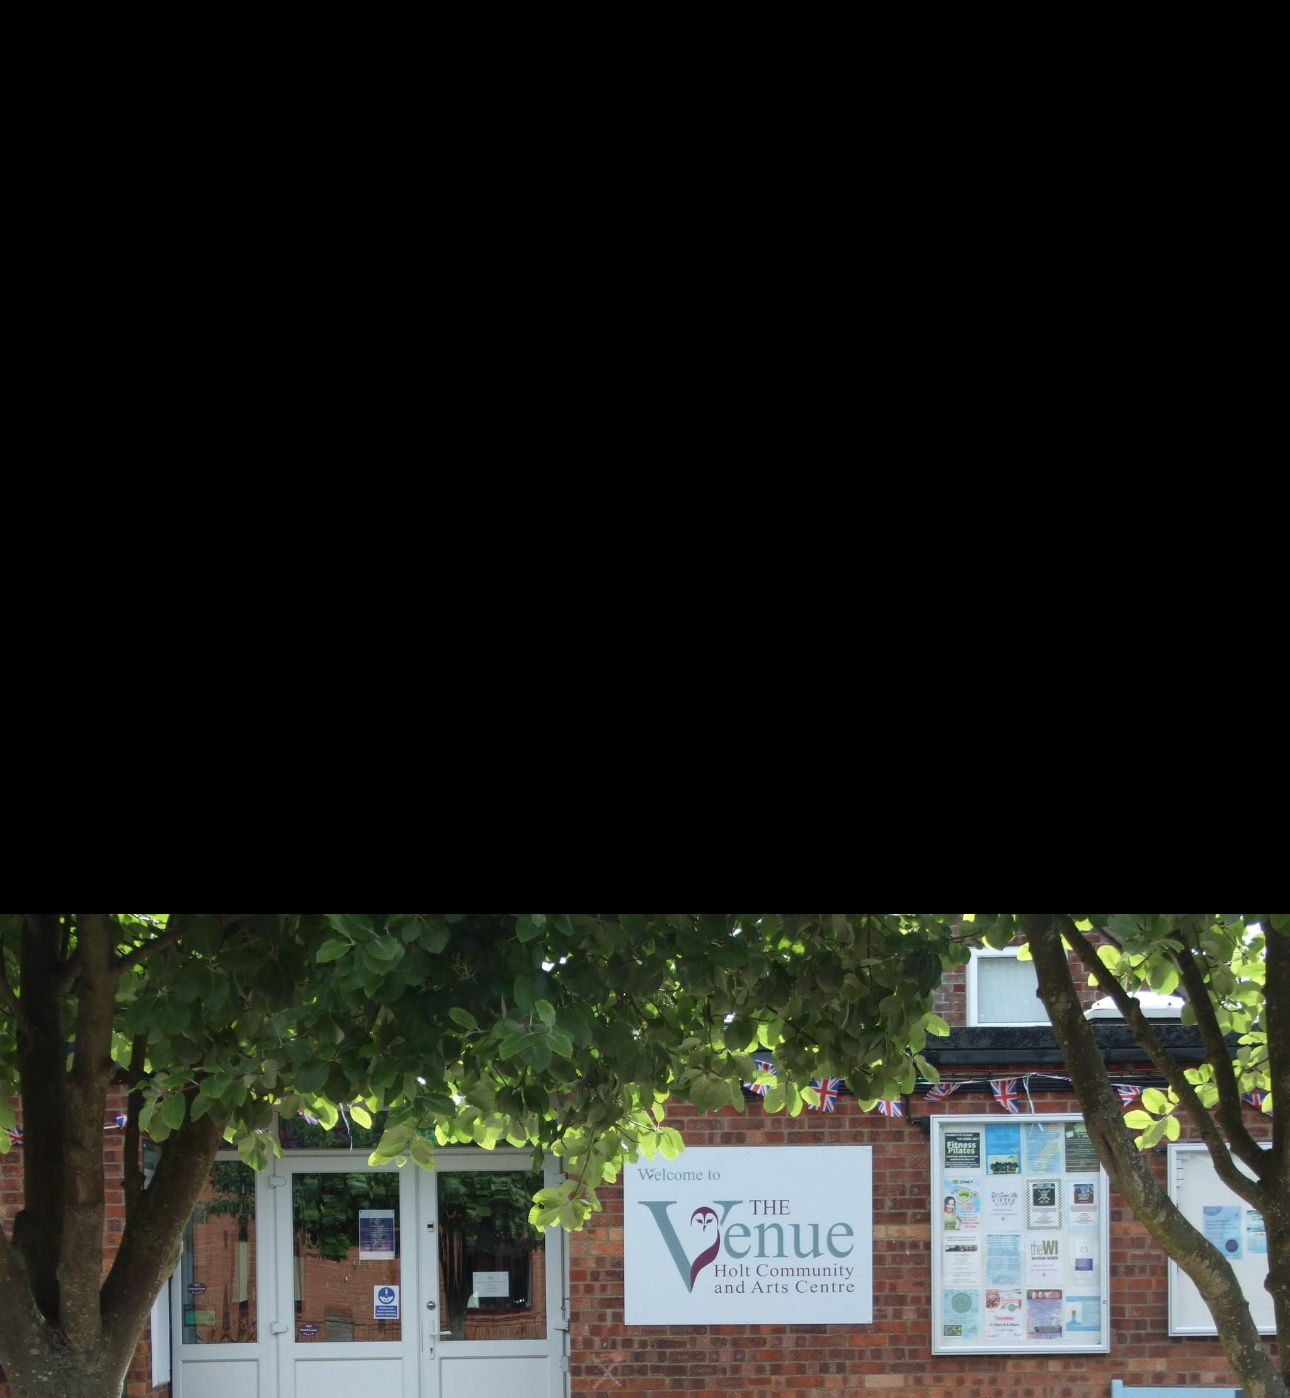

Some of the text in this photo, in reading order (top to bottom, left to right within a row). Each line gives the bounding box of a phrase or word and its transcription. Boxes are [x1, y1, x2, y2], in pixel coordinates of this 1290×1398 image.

[946, 1141, 977, 1149] Fitness
[638, 1168, 721, 1181] Welcome to
[749, 1199, 790, 1216] THE
[637, 1200, 855, 1294] Venue
[714, 1263, 855, 1280] Holt Community
[714, 1280, 855, 1294] and Arts Centre
